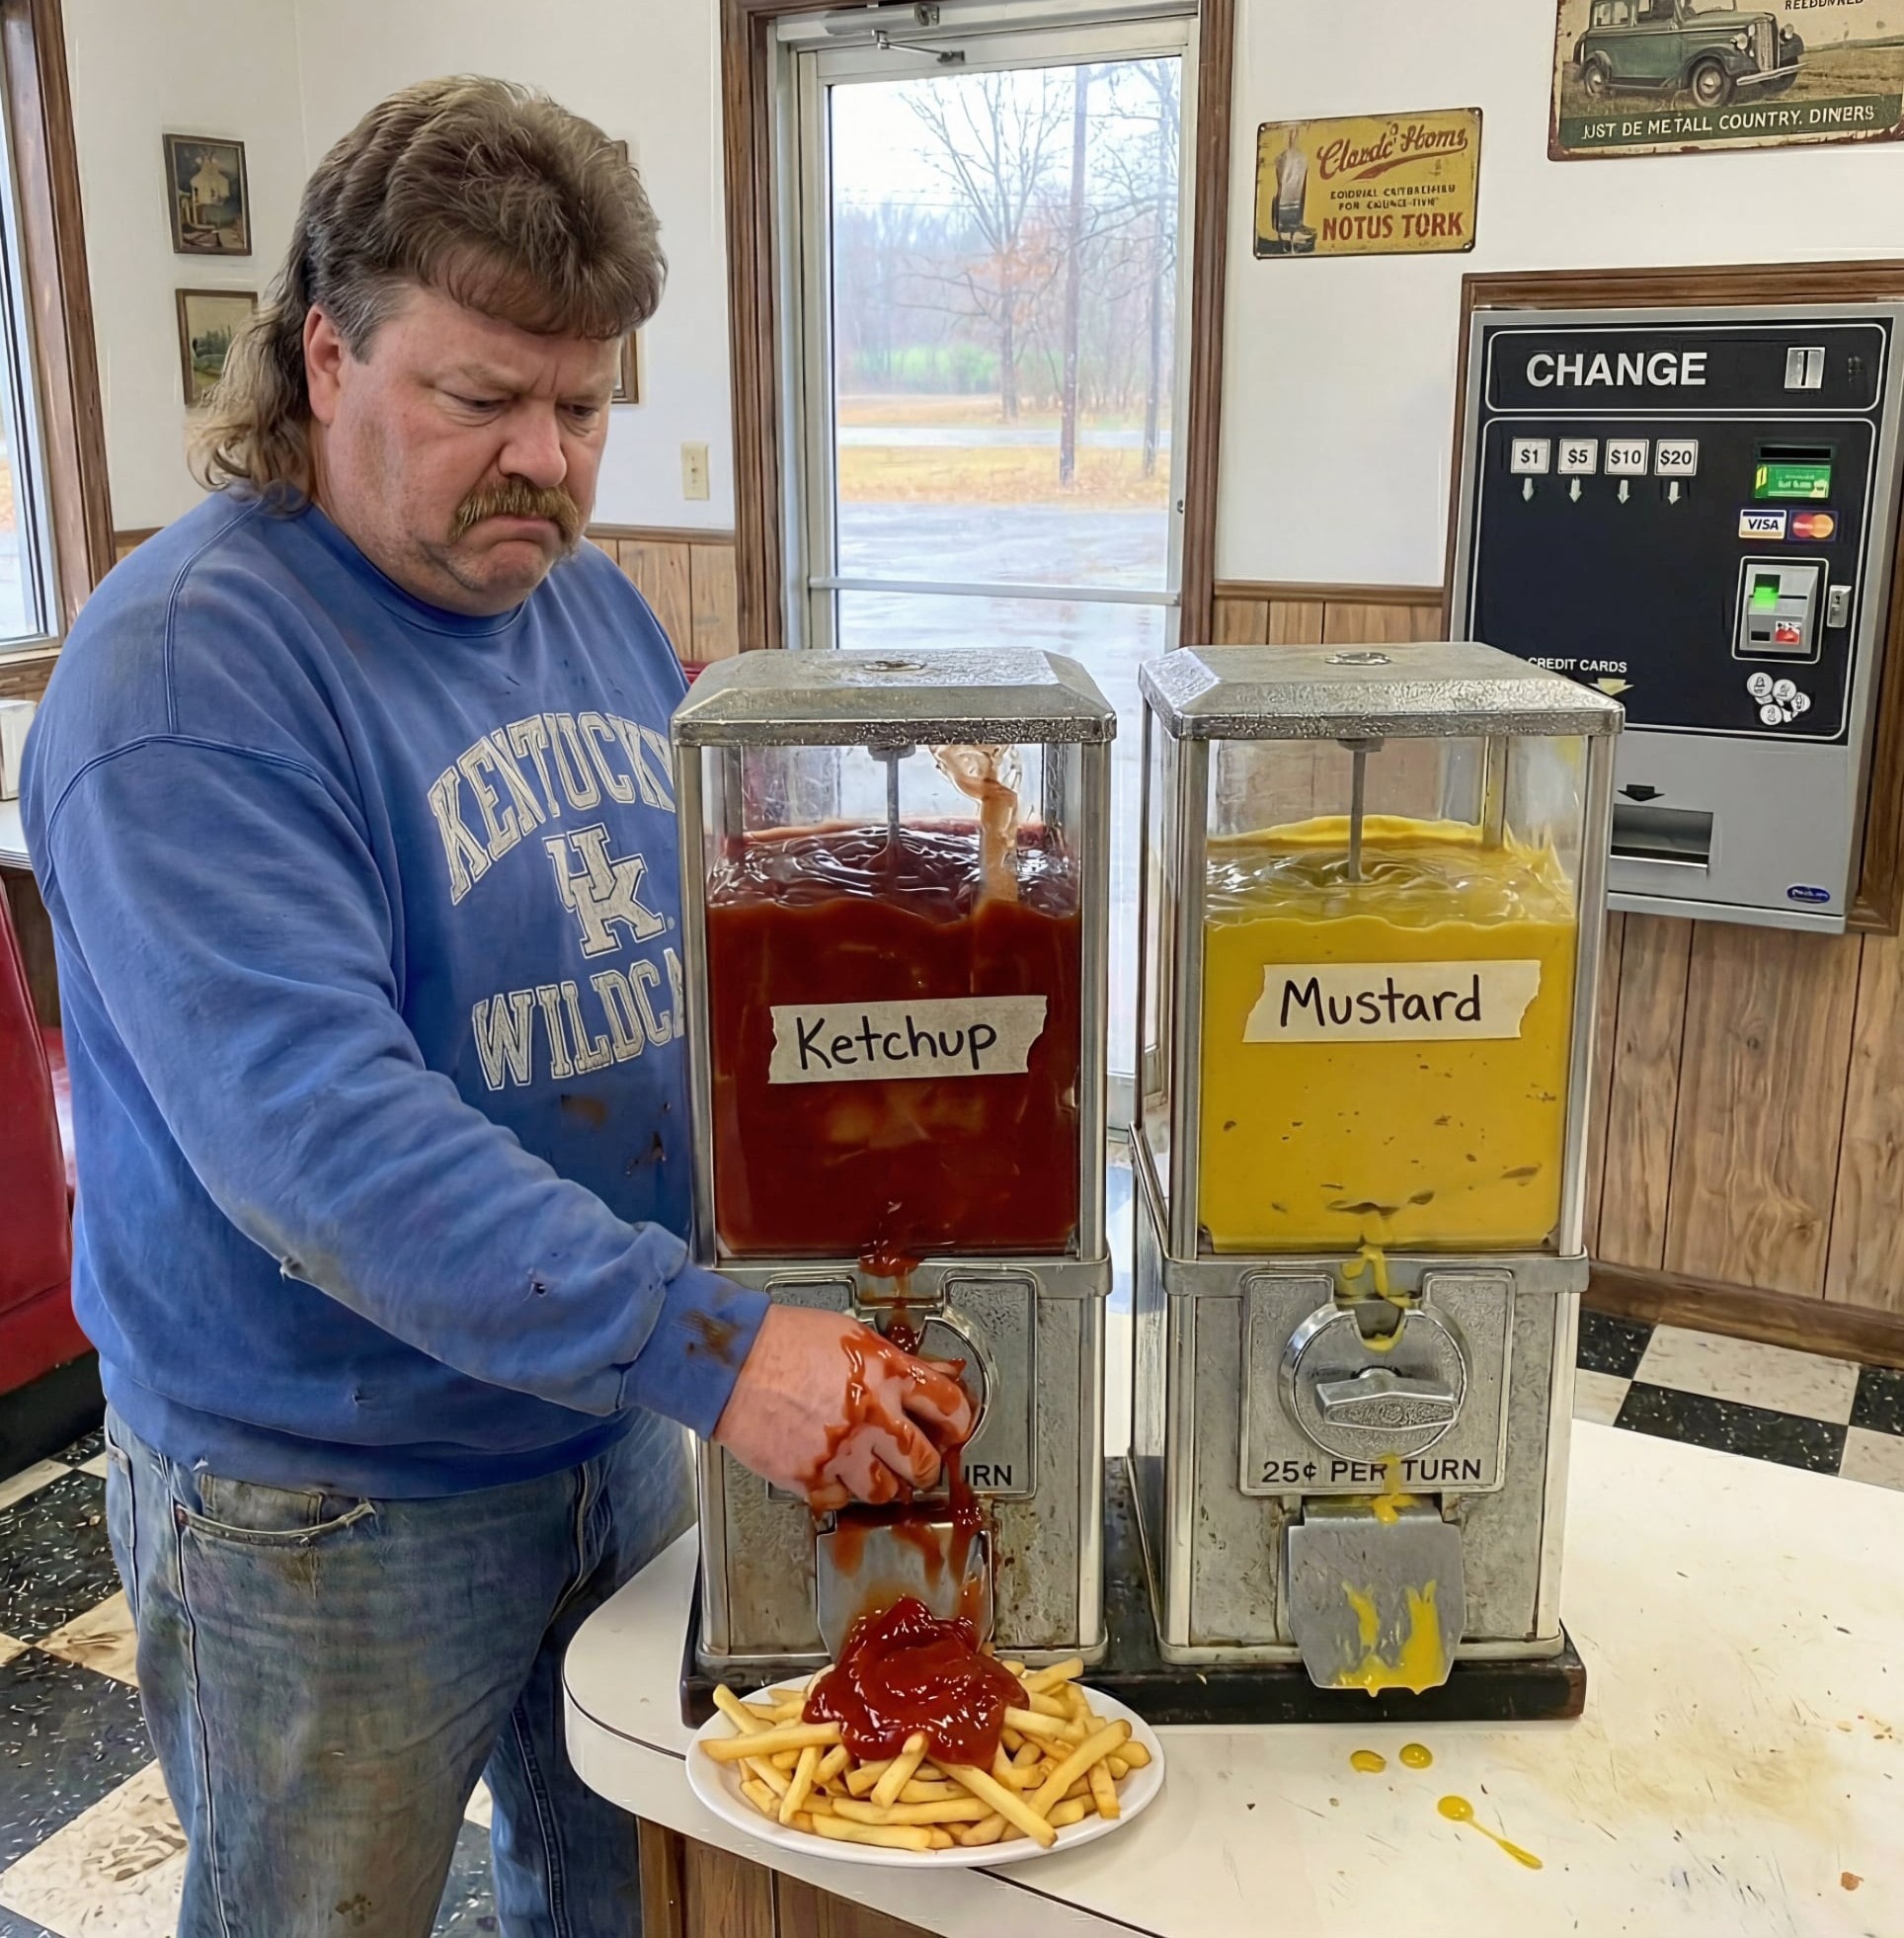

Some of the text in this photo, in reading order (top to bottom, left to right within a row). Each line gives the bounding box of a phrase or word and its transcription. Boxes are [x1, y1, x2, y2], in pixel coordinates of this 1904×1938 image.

[1622, 121, 1642, 136] DE
[1809, 105, 1874, 123] DINERS
[1322, 211, 1464, 241] NOTUS TORK
[1526, 352, 1707, 386] CHANGE
[1521, 447, 1539, 465] $1
[1567, 447, 1588, 465] $5
[1611, 448, 1641, 465] $10
[1660, 448, 1692, 466] $20
[1748, 519, 1779, 530] VISA
[1580, 659, 1627, 673] CARDS
[542, 823, 666, 958] UK
[1280, 974, 1481, 1027] Mustard
[796, 1015, 996, 1070] Ketchup
[1261, 1458, 1481, 1483] 25¢ PER TURN
